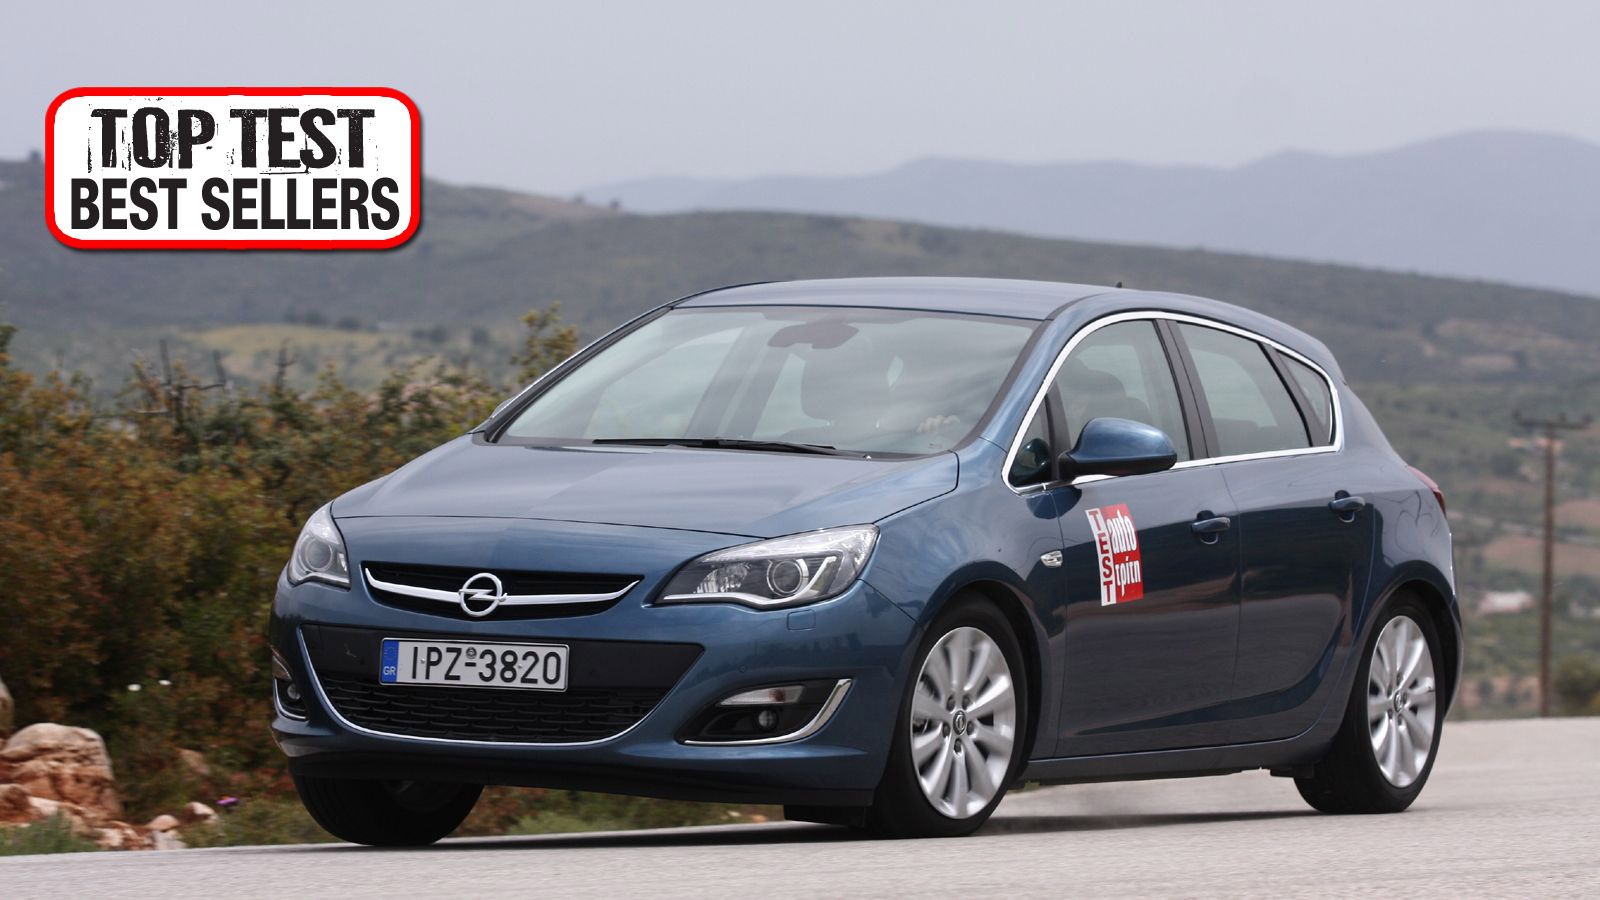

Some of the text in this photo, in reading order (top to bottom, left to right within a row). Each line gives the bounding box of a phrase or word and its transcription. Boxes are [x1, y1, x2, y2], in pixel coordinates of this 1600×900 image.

[1106, 509, 1137, 554] auto
[1088, 510, 1113, 603] TEST
[383, 666, 396, 676] GR
